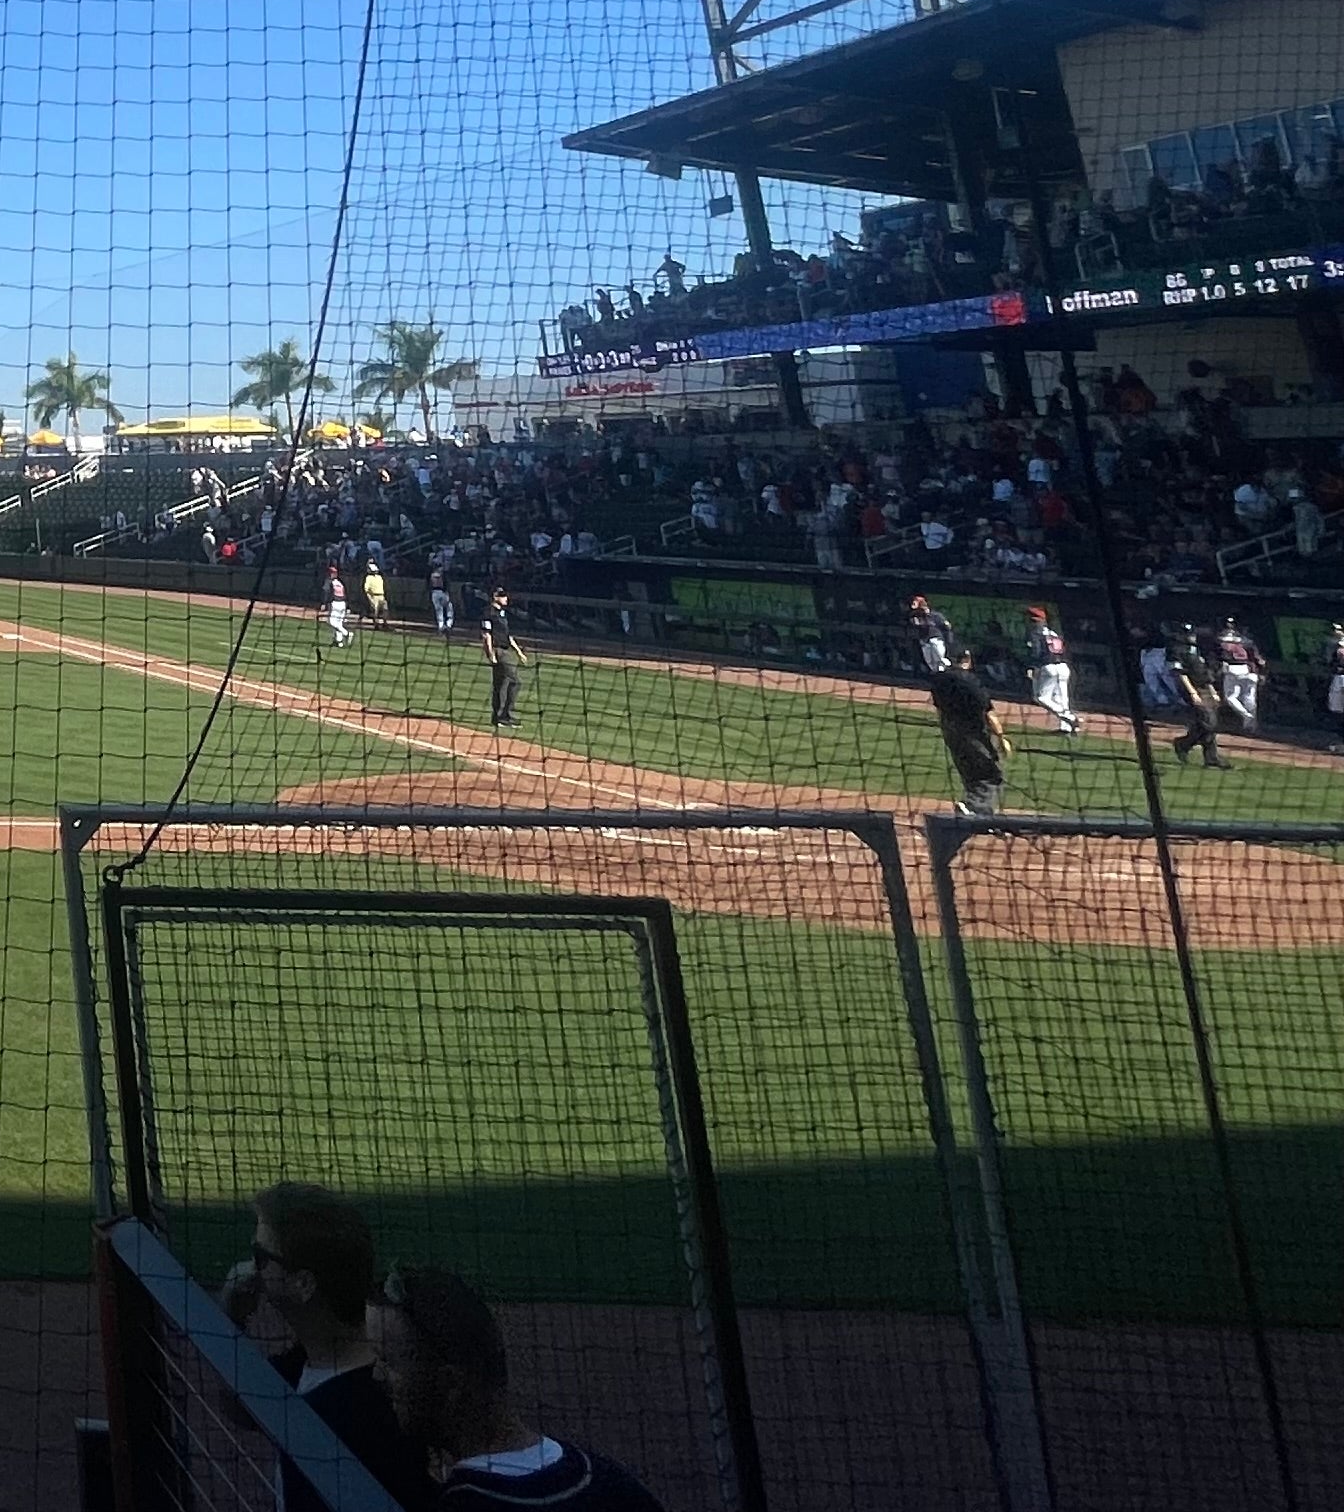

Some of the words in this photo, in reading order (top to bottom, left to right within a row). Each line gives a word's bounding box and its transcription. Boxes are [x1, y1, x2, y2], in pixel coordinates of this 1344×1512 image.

[1233, 282, 1246, 296] 5
[1252, 278, 1279, 294] 12
[1286, 274, 1309, 290] 17
